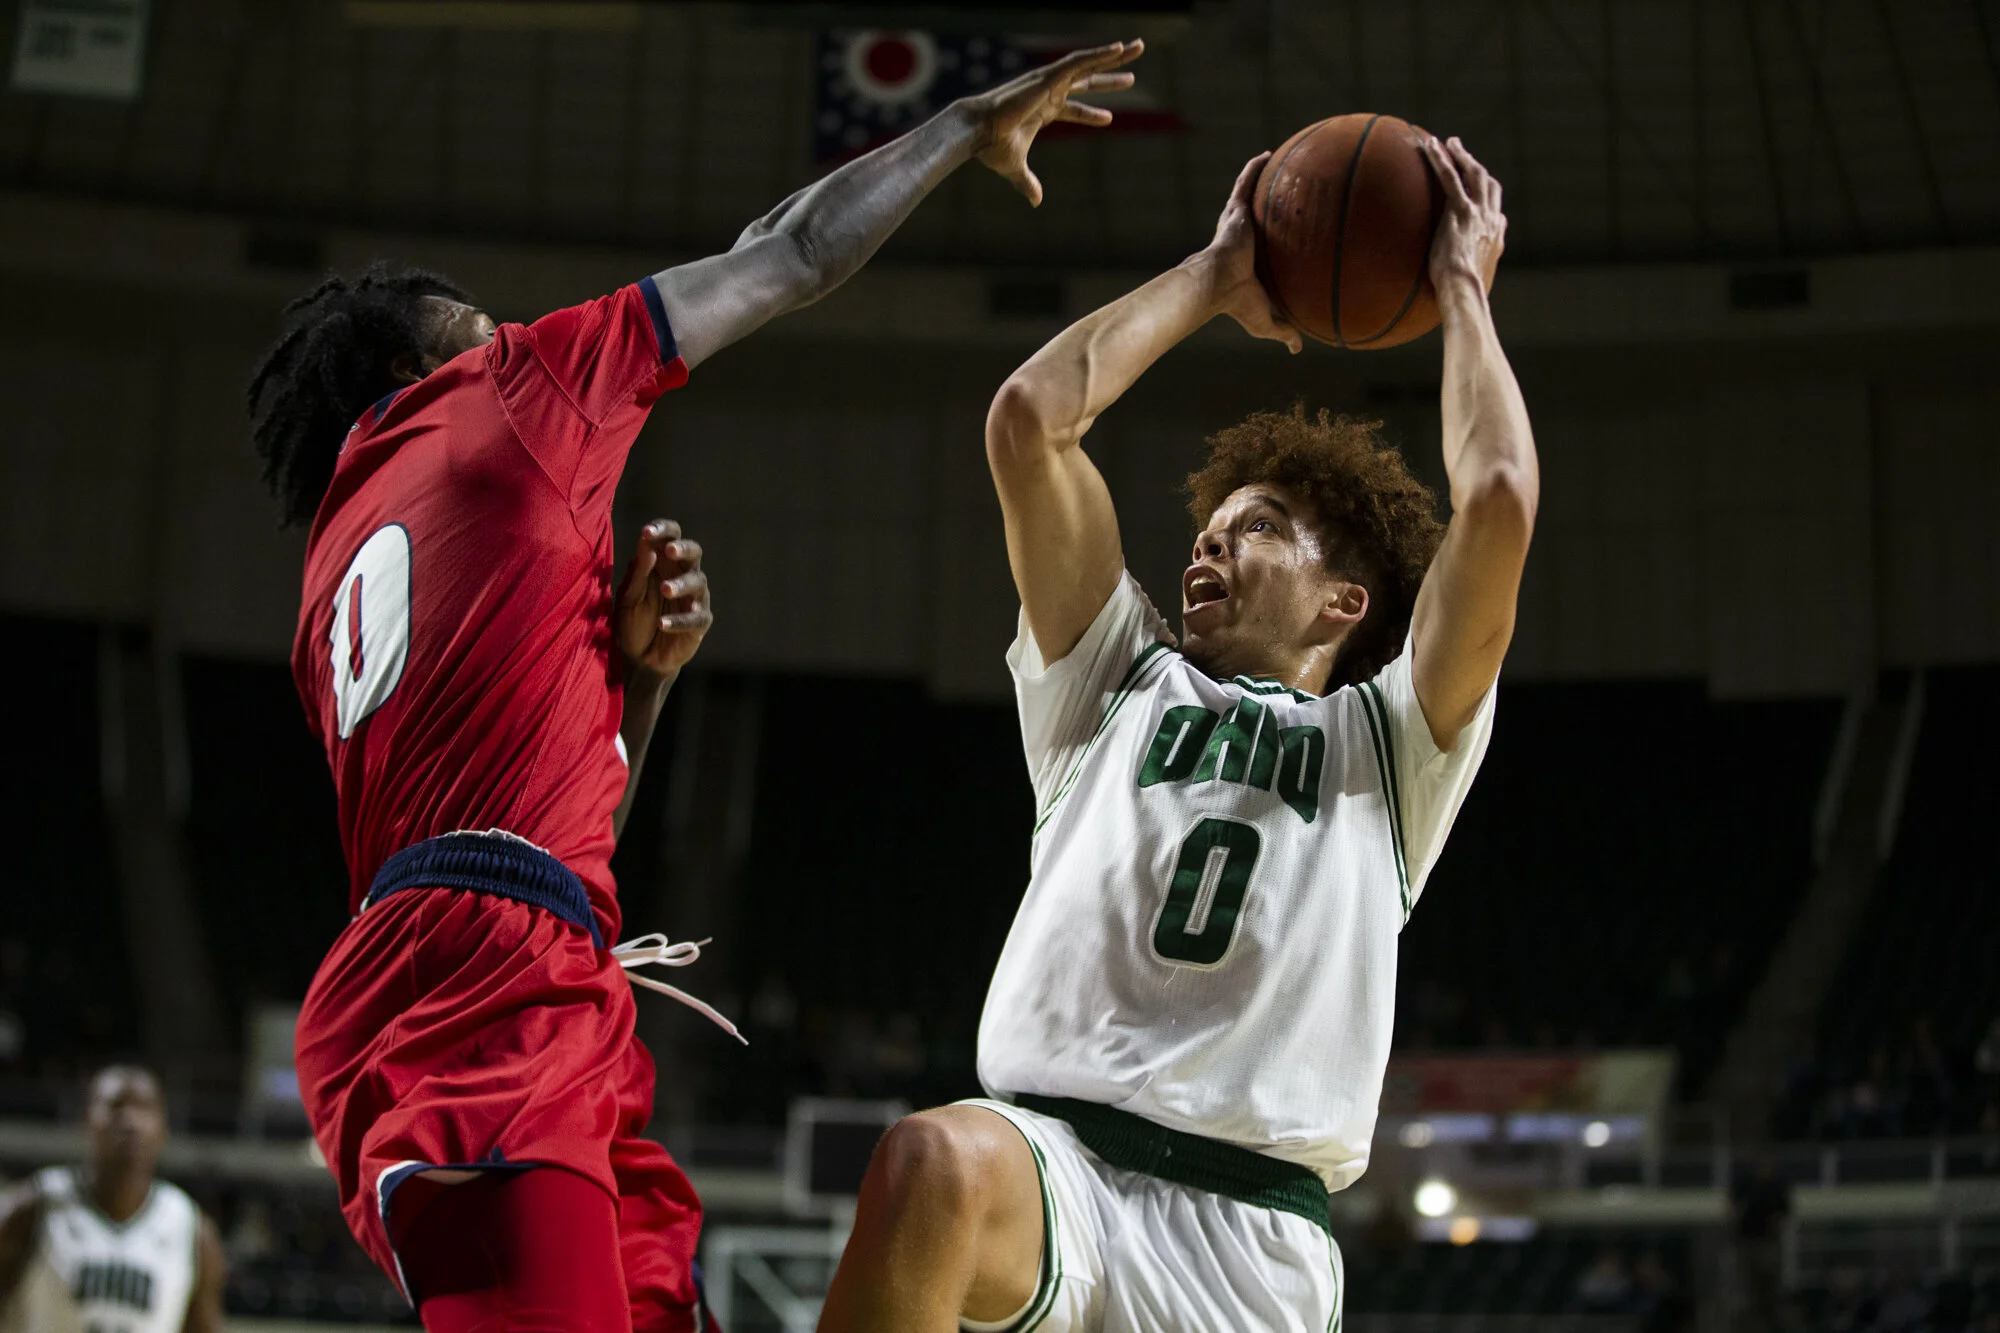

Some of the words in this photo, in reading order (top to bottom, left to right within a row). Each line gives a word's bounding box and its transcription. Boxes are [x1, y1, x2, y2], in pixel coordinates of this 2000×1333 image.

[329, 521, 413, 743] 0
[1137, 696, 1325, 824] OHIO
[1150, 813, 1264, 971] 0
